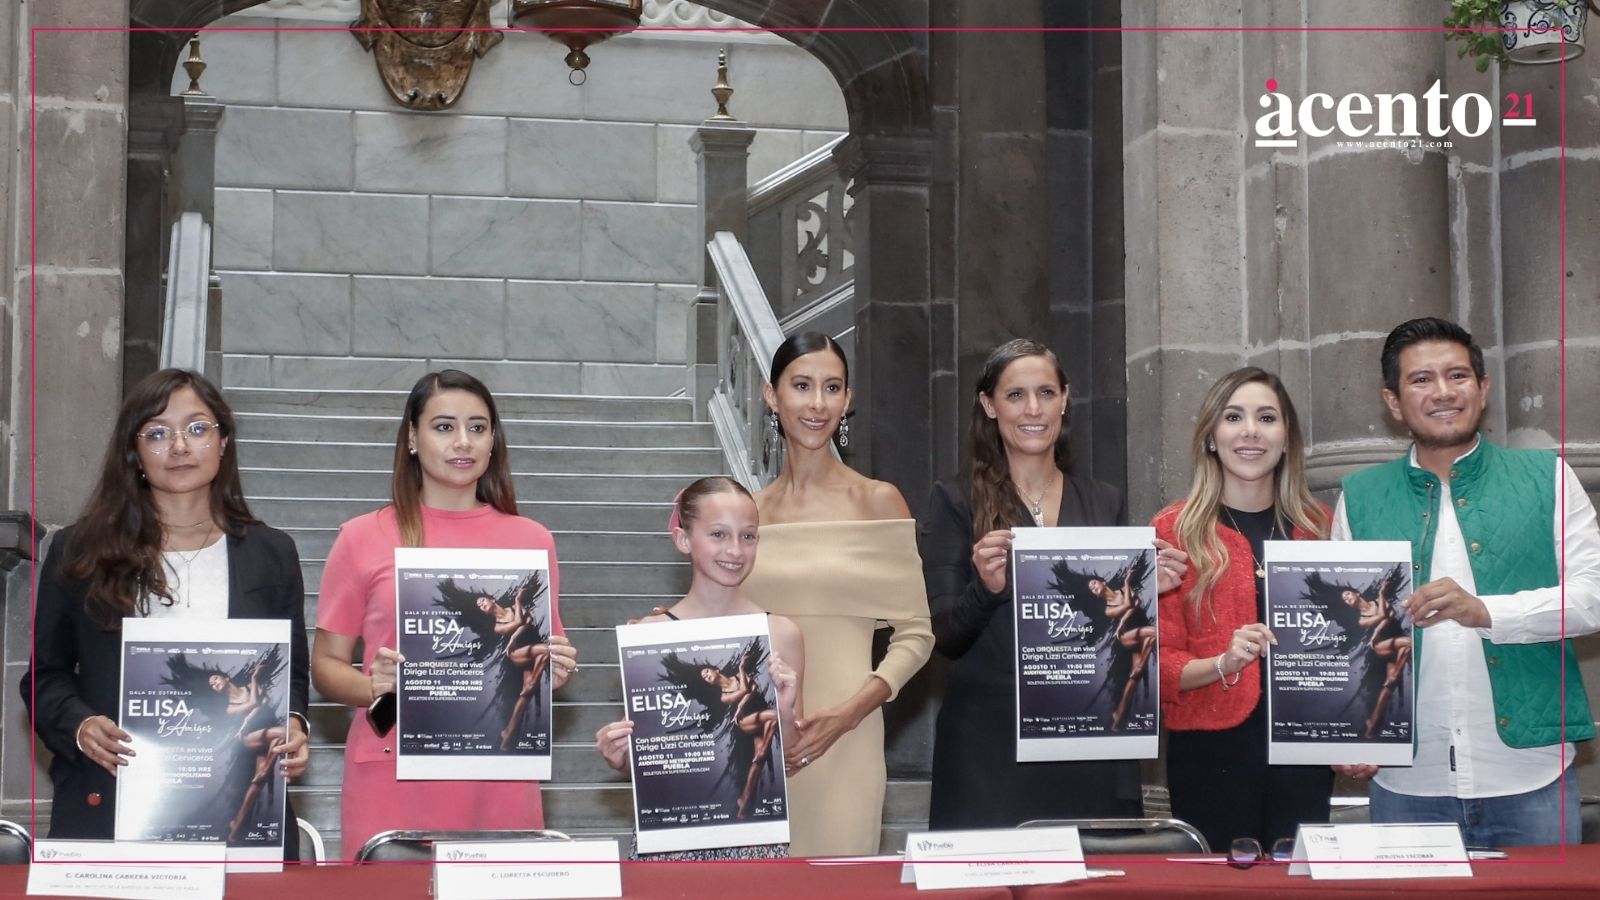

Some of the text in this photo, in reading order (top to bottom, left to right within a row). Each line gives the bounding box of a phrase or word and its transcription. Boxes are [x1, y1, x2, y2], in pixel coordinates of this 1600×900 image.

[1022, 603, 1073, 619] ELISA
[405, 619, 460, 634] ELISA
[1048, 611, 1094, 639] y Amigos
[1274, 612, 1326, 628] ELISA
[432, 627, 482, 654] y Amigos
[1300, 620, 1348, 648] y Amigos
[128, 700, 190, 716] ELISA
[632, 693, 686, 712] ELISA
[661, 699, 711, 727] y Amigos
[158, 708, 212, 739] y Amigos
[636, 740, 715, 752] Dirige Lizzi Ceniceros
[651, 735, 688, 743] ORQUESTA
